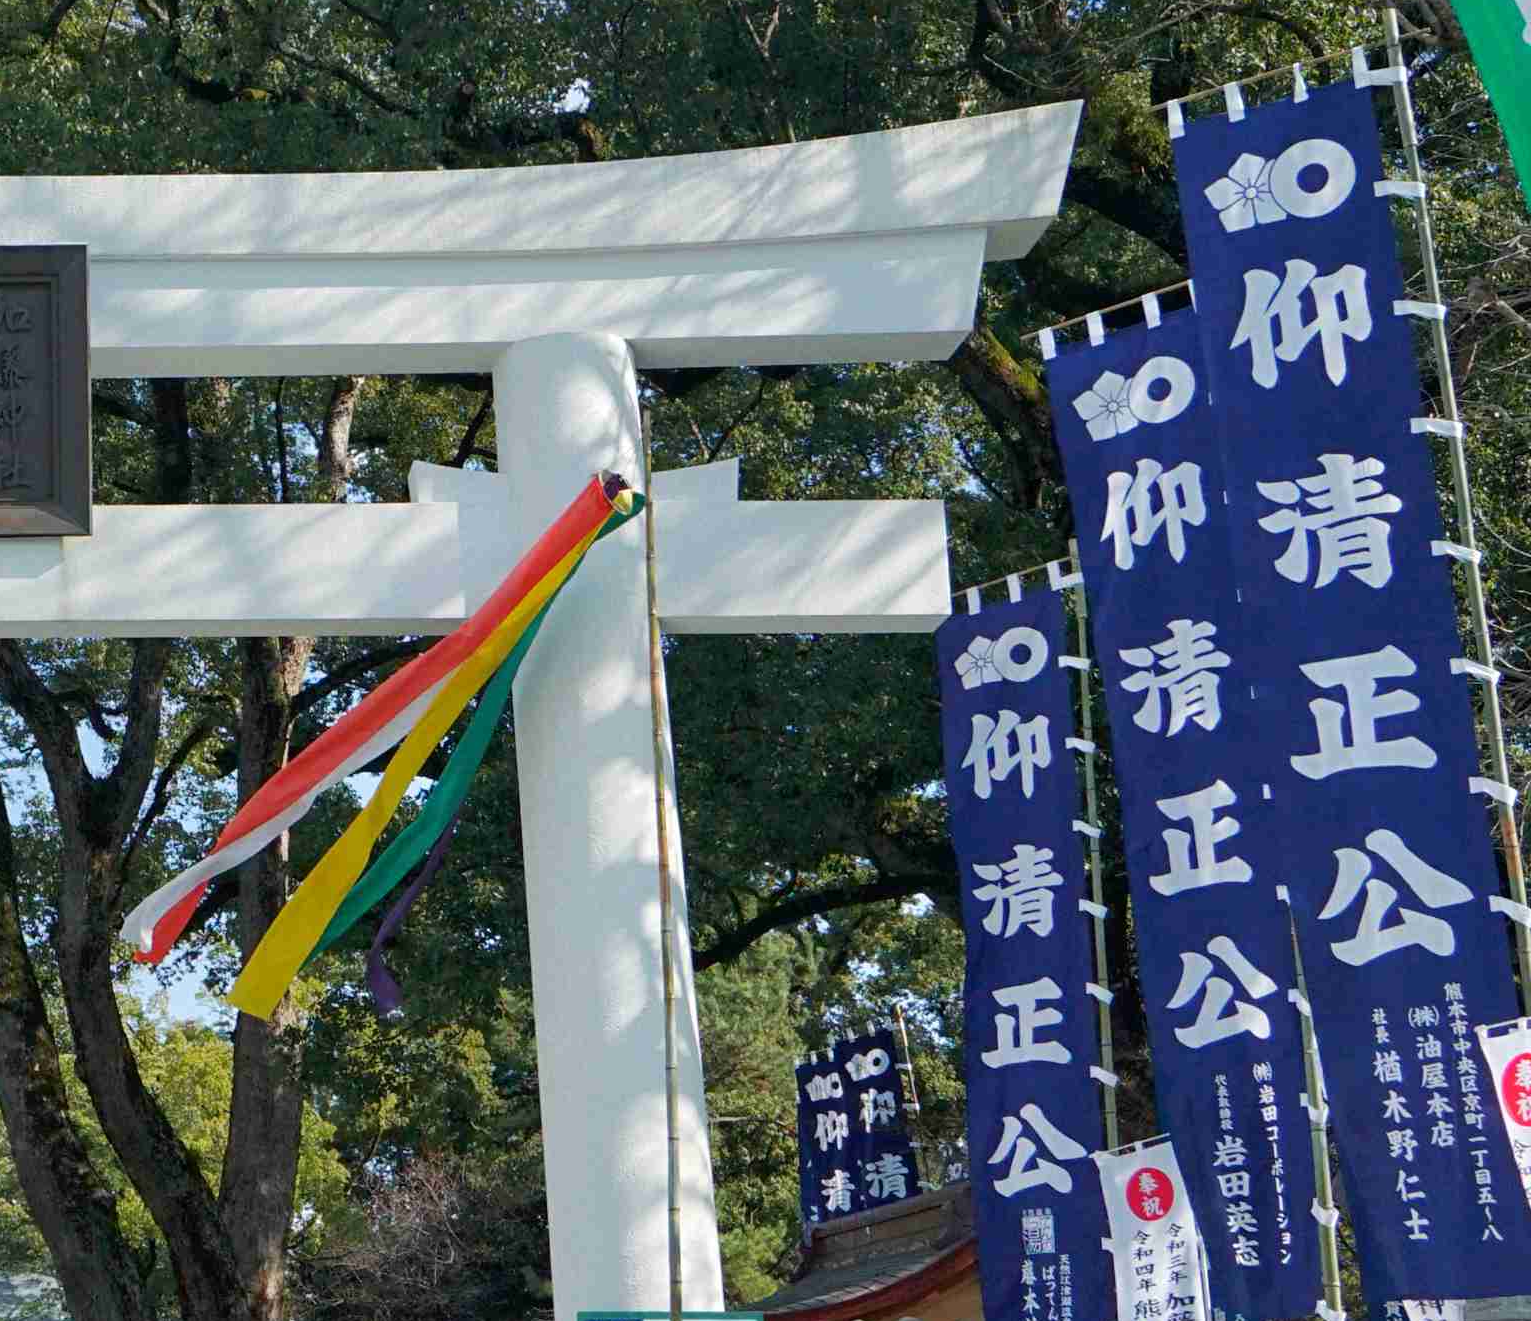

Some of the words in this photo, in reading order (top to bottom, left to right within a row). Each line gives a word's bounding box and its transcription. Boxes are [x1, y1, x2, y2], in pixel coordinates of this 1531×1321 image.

[1230, 258, 1475, 968] 仰清正公
[1102, 458, 1279, 1050] 仰清正公
[962, 709, 1084, 1203] 仰清正公
[1371, 1008, 1389, 1044] 社長
[1139, 1172, 1165, 1218] 奉祝
[1212, 1135, 1260, 1267] 岩田英志
[1132, 1229, 1158, 1293] 令和四年
[1165, 1222, 1190, 1283] 令和三年
